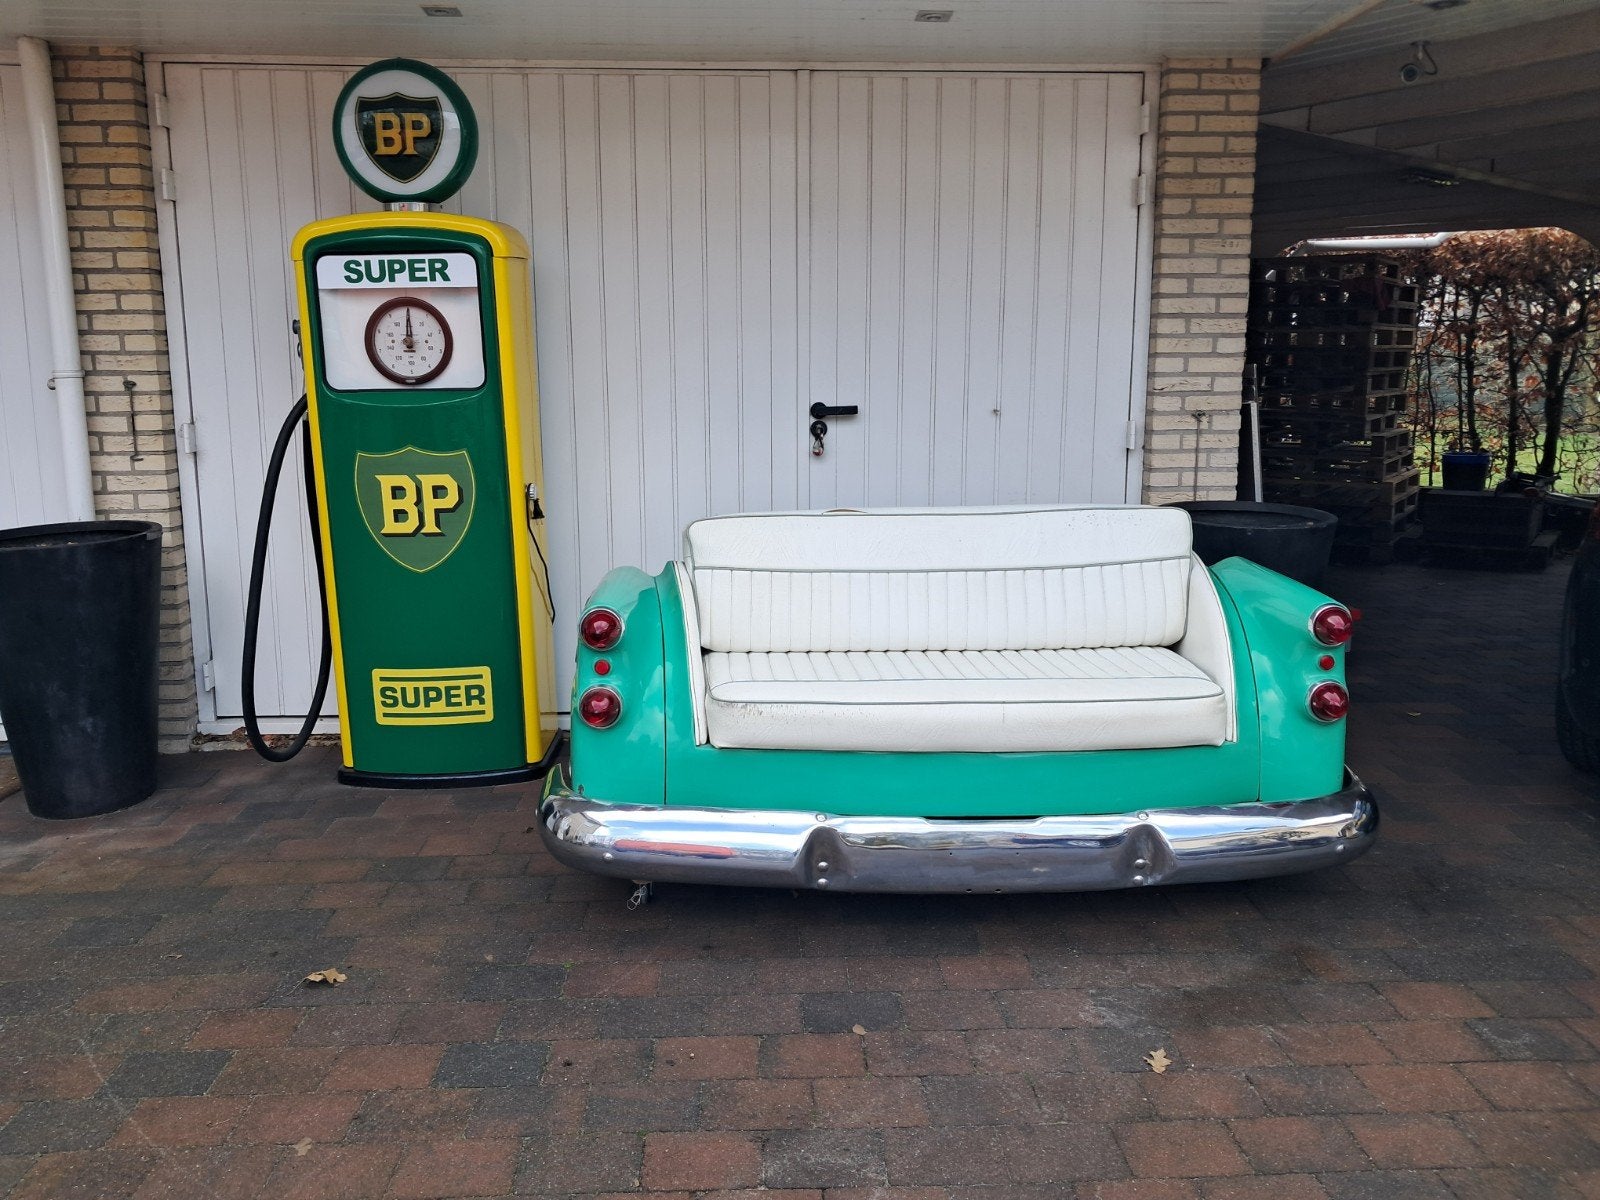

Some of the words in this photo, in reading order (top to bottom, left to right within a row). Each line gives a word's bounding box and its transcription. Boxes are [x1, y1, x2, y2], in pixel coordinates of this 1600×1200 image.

[372, 112, 432, 156] BP
[343, 258, 451, 284] SUPER
[374, 474, 462, 536] BP
[379, 684, 486, 708] SUPER
